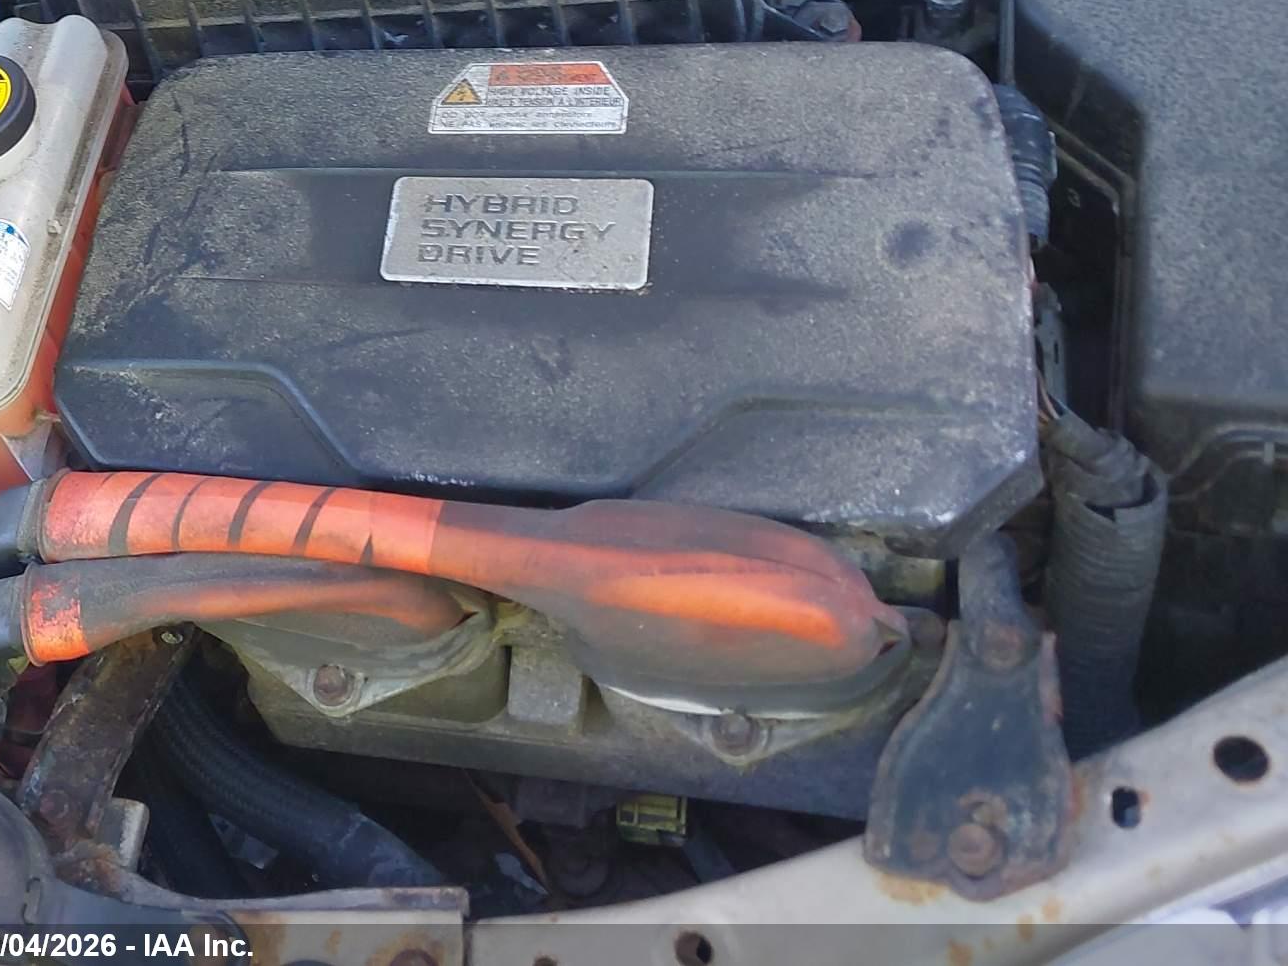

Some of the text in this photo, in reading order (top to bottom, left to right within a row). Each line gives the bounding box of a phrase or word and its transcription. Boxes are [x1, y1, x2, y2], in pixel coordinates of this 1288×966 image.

[574, 86, 611, 96] INSIDE
[424, 194, 579, 216] HYBRID
[420, 218, 616, 242] SYNERGY
[417, 242, 541, 266] DRIVE
